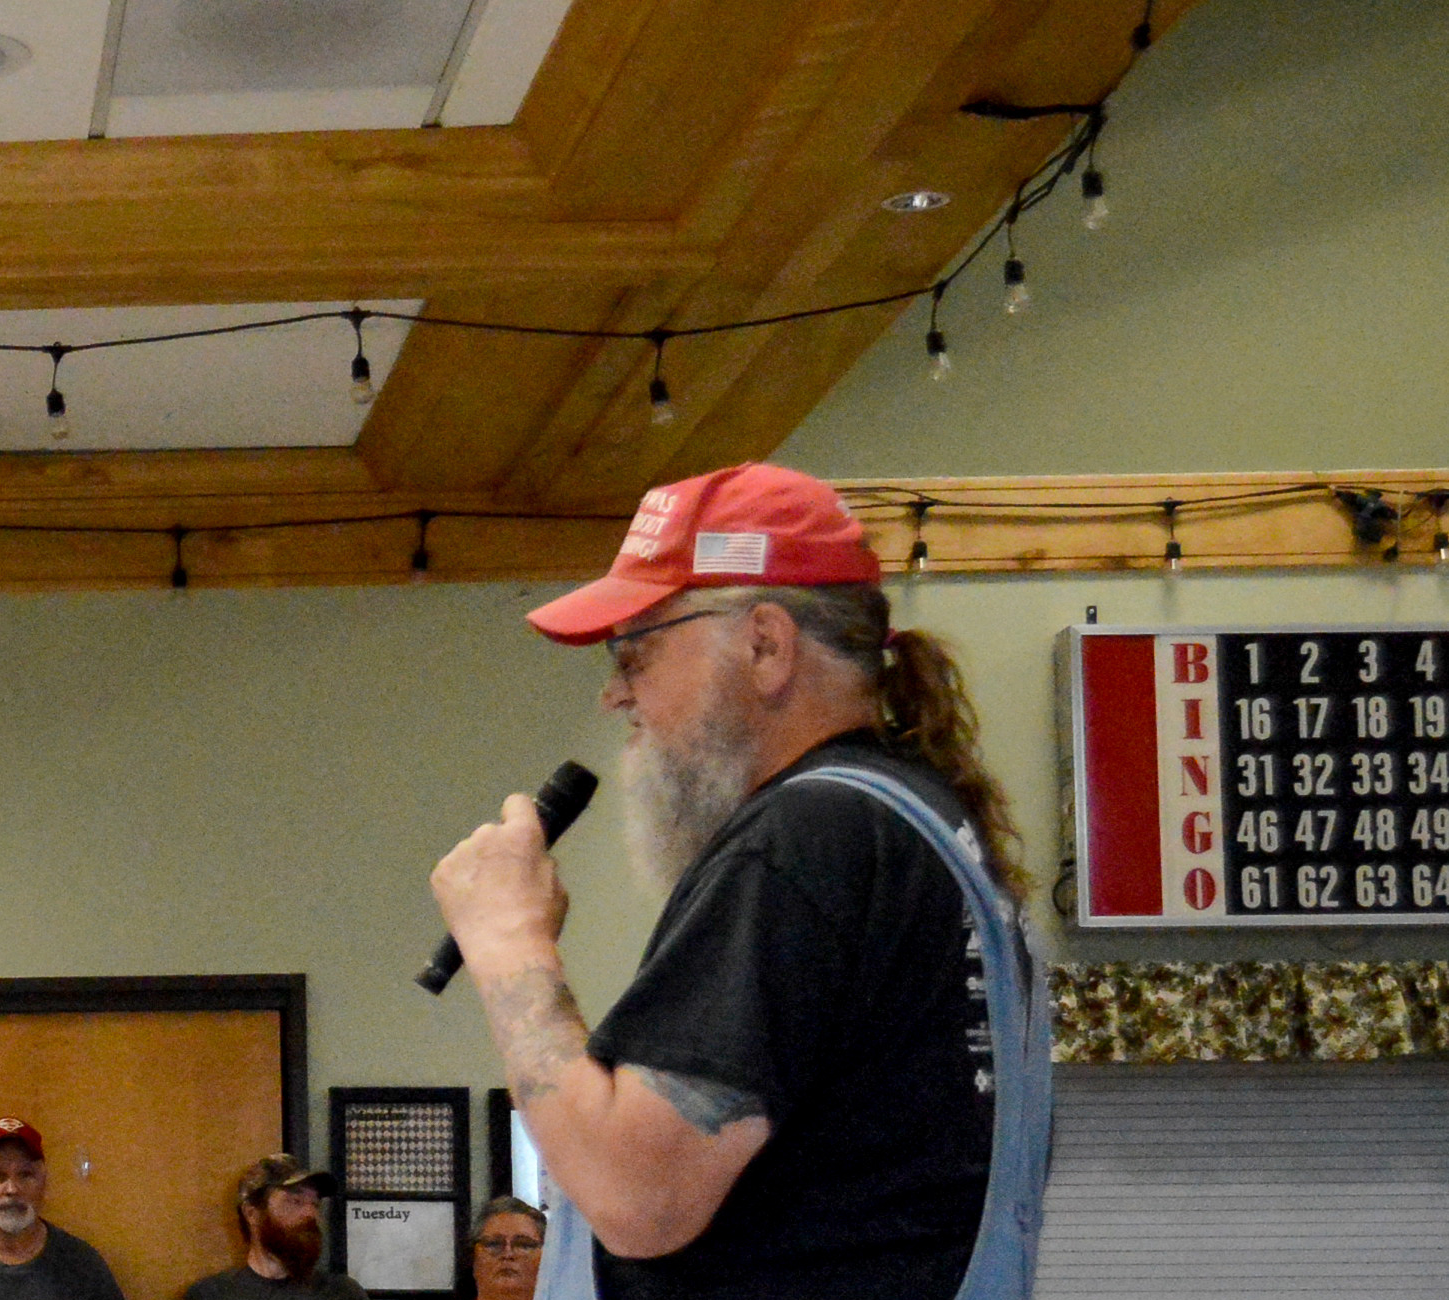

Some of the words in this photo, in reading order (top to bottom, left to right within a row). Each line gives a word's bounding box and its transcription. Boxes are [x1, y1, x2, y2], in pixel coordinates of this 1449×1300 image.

[1244, 642, 1259, 685] 1
[1300, 640, 1320, 683] 2
[1359, 639, 1378, 683] 3
[1415, 639, 1435, 682] 4
[1236, 697, 1272, 740] 16
[1294, 697, 1330, 740] 17
[1352, 696, 1389, 739] 18
[1409, 695, 1447, 738] 19
[1170, 642, 1216, 911] BINGO
[1236, 754, 1274, 797] 31
[1293, 753, 1336, 796] 32
[1352, 752, 1393, 795] 33
[1407, 751, 1449, 794] 34
[1236, 810, 1279, 852] 46
[1294, 809, 1336, 852] 47
[1353, 808, 1396, 851] 48
[1410, 807, 1449, 850] 49
[1240, 866, 1279, 909] 61
[1297, 865, 1340, 908] 62
[1355, 864, 1397, 907] 63
[1411, 864, 1449, 907] 64
[351, 1207, 411, 1223] Tuesday
